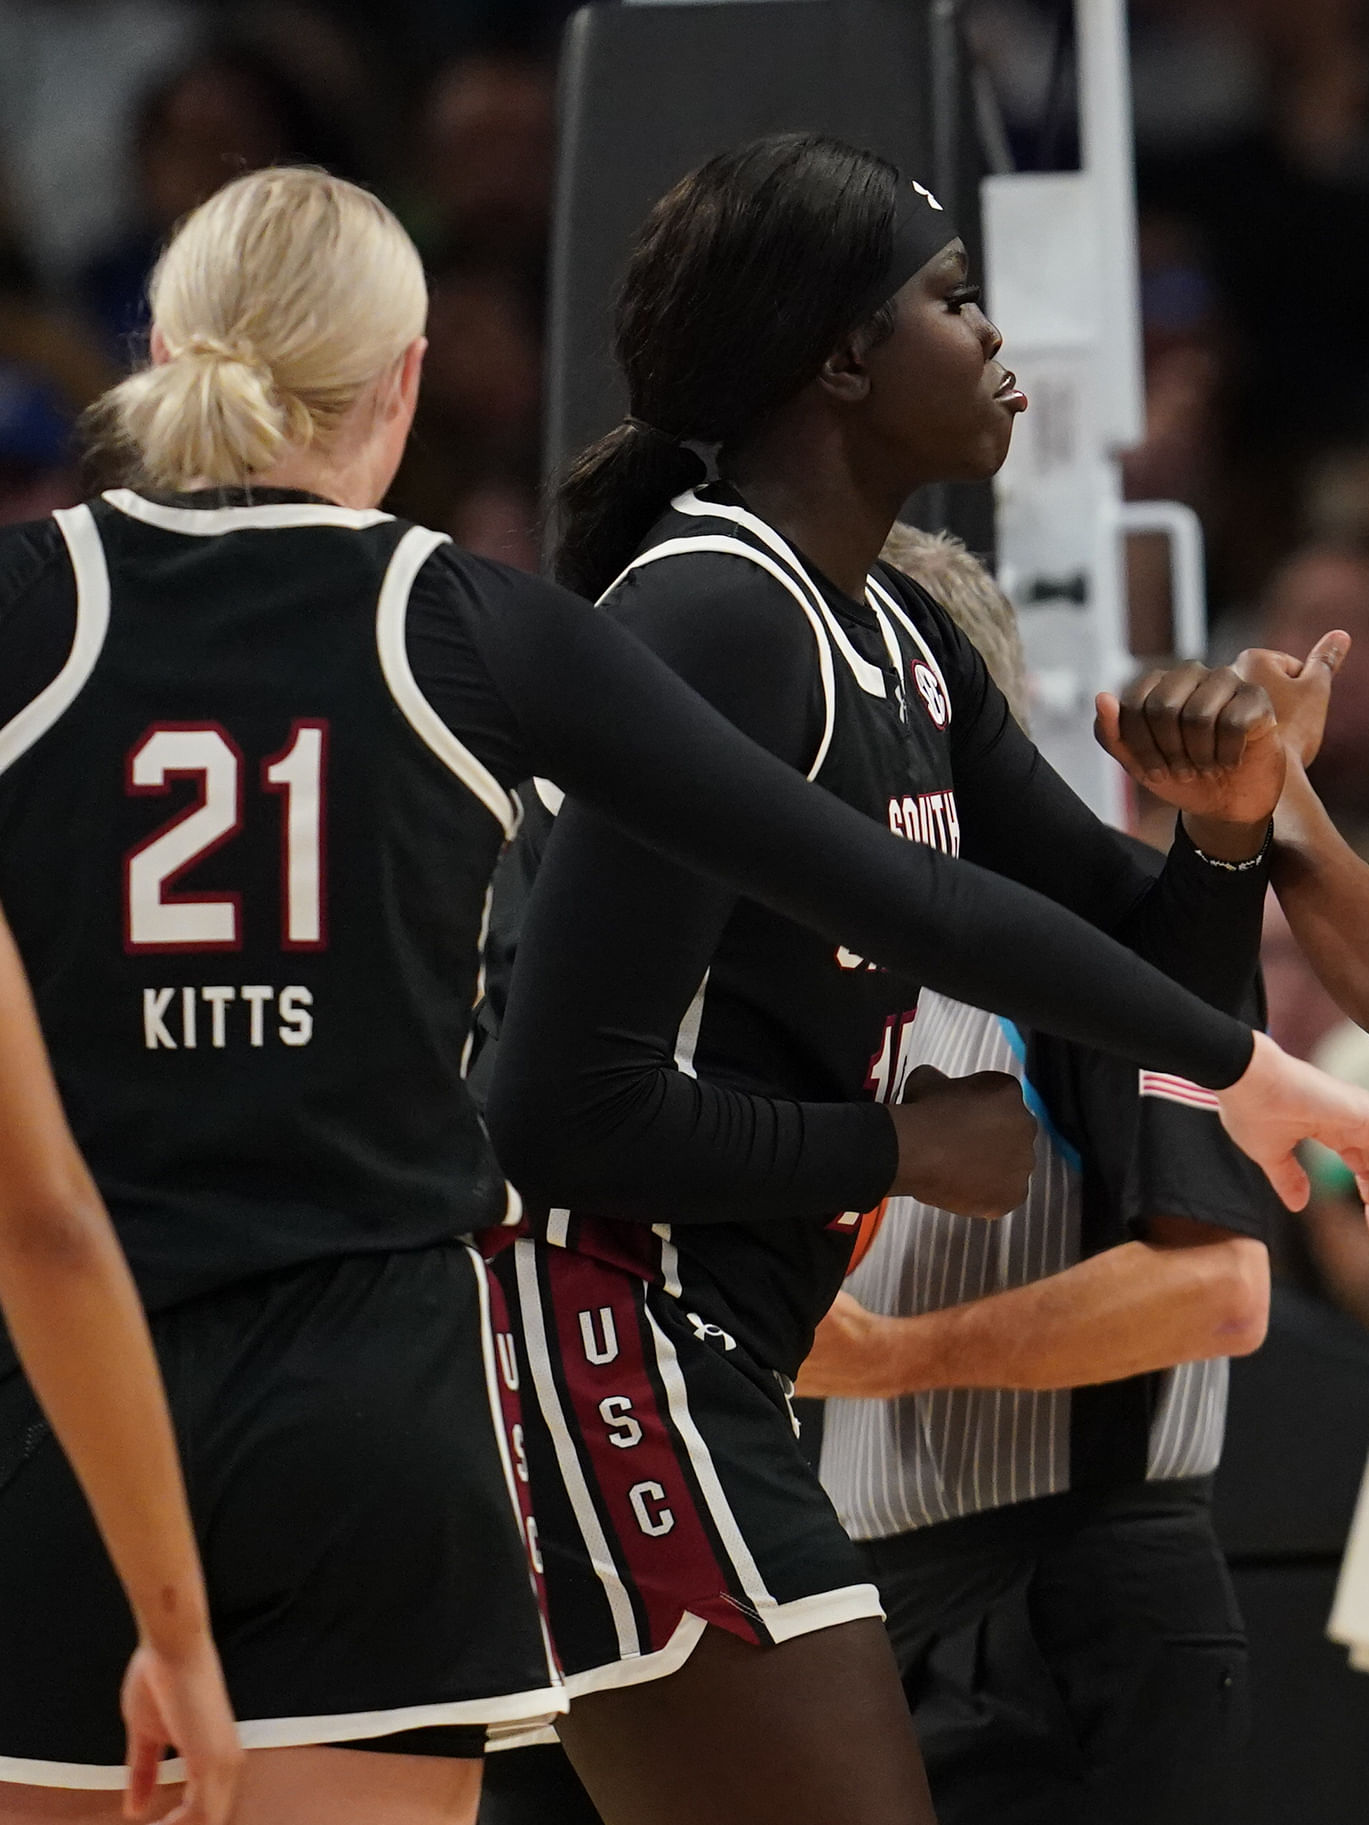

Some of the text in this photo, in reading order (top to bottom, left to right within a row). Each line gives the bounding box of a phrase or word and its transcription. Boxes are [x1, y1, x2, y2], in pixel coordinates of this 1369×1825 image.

[125, 717, 329, 955] 21
[143, 985, 313, 1049] KITTS
[578, 1306, 675, 1538] USC
